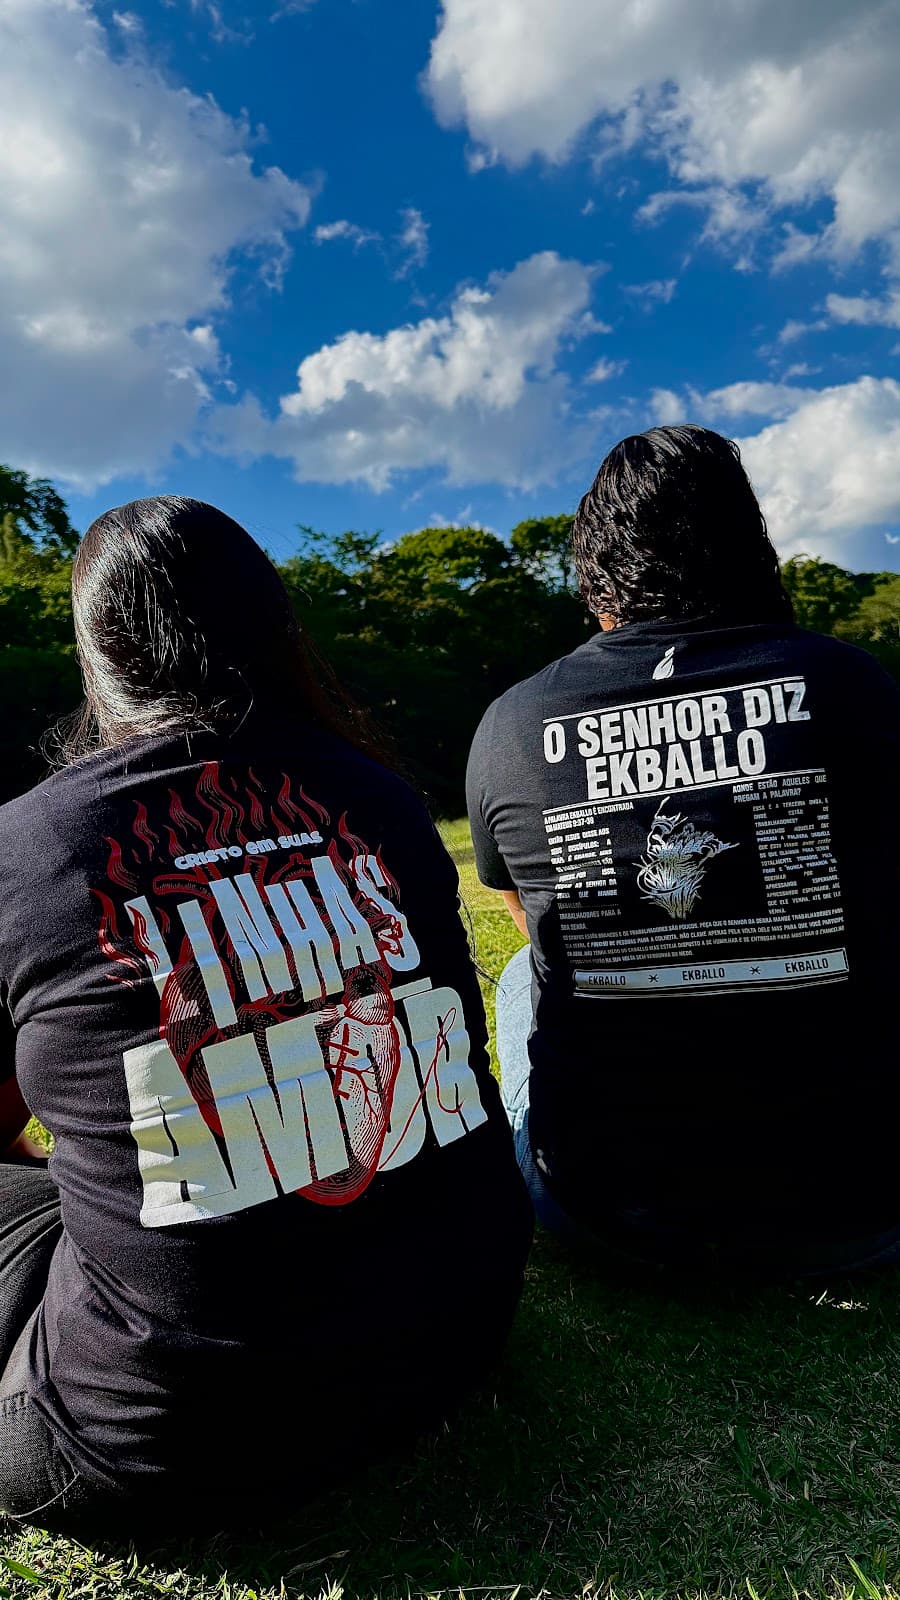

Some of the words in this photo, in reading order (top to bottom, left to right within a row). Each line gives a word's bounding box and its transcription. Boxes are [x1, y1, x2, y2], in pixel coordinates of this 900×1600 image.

[544, 723, 566, 763] O
[577, 696, 732, 758] SENHOR
[742, 682, 811, 728] DIZ
[586, 729, 766, 800] EKBALLO
[733, 783, 753, 793] AONDE
[758, 779, 777, 789] ESTÃO
[782, 777, 810, 786] AQUELES
[815, 775, 826, 783] QUE
[734, 793, 760, 803] PREGAM
[770, 788, 801, 798] PALAVRA?
[174, 846, 242, 869] CRISTO
[278, 831, 323, 848] SUAS
[124, 855, 420, 1028] LINHAS
[588, 976, 626, 986] EKBALLO
[682, 967, 725, 981] EKBALLO
[785, 958, 829, 973] EKBALLO
[123, 977, 487, 1227] AMOR
